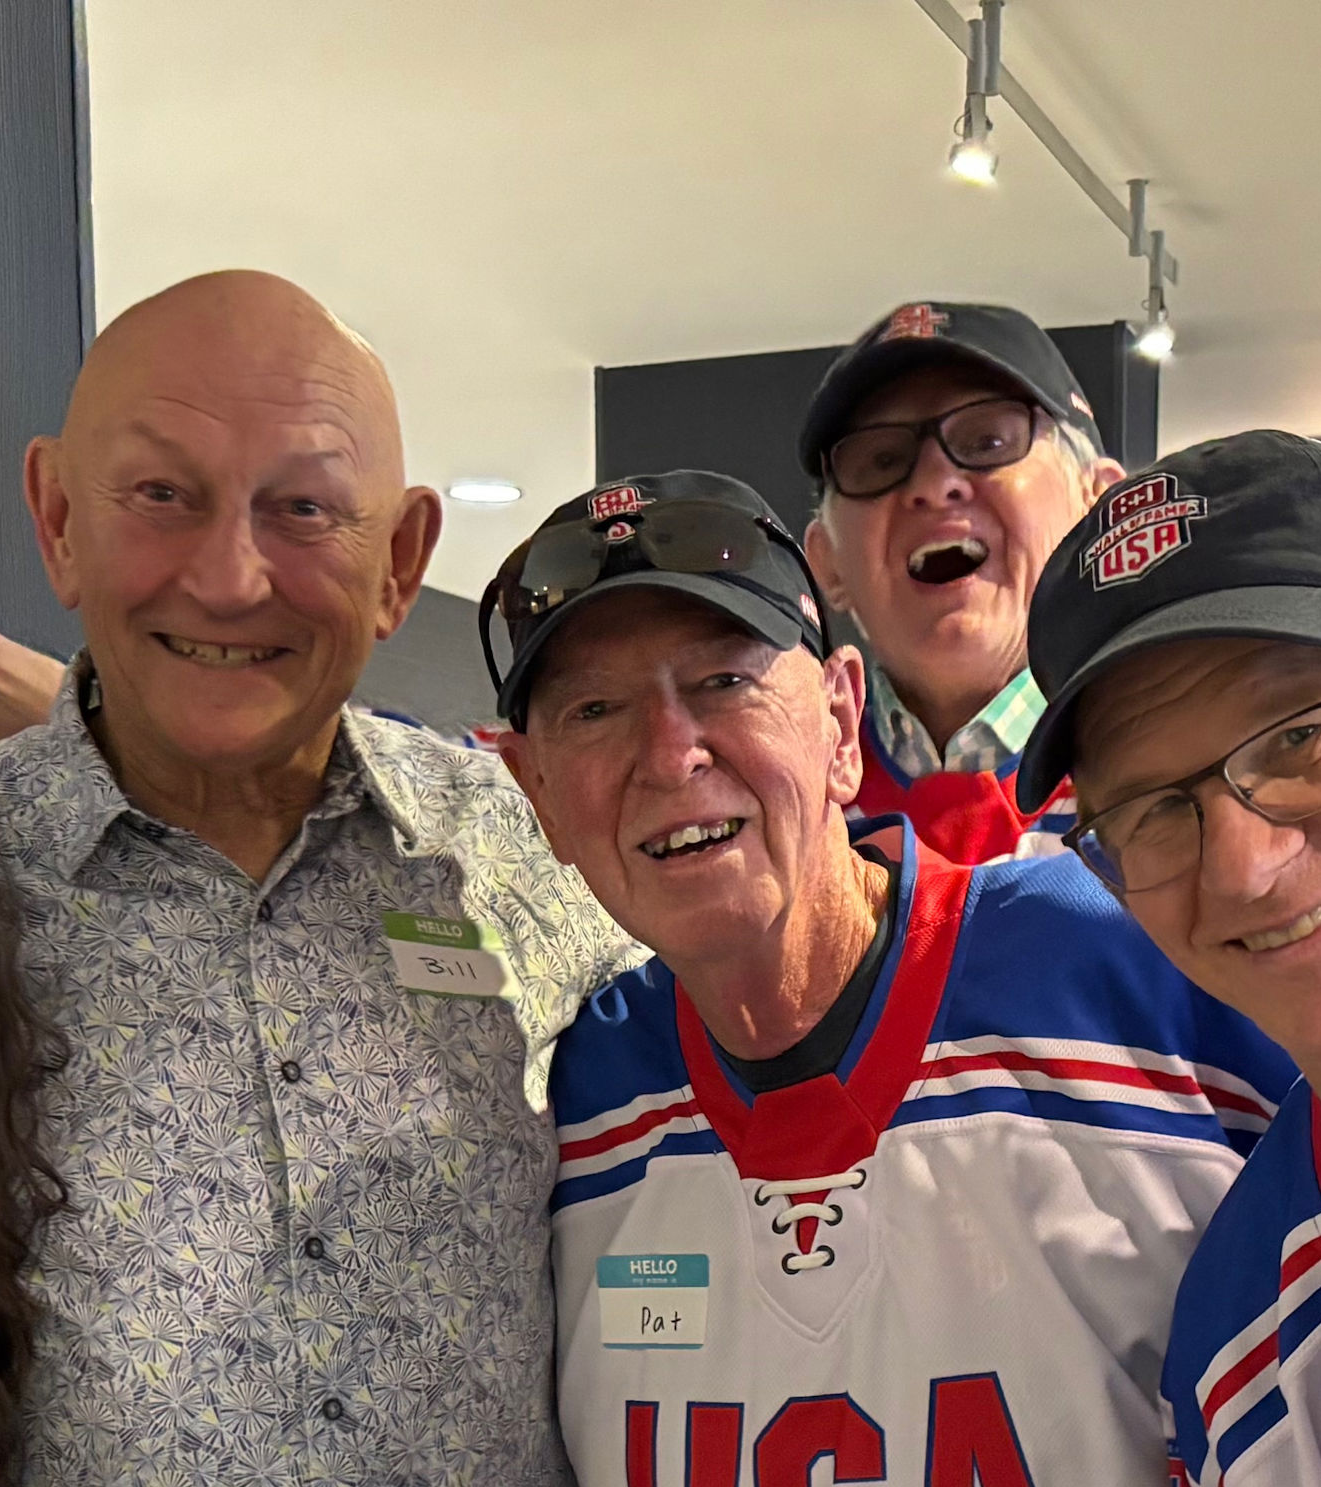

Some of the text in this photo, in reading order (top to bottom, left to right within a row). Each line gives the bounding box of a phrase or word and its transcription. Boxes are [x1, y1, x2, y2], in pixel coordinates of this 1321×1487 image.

[1103, 523, 1178, 578] USA
[414, 919, 463, 938] HELLO
[418, 956, 477, 980] Bill
[630, 1259, 678, 1275] HELLO
[641, 1306, 682, 1335] Pat
